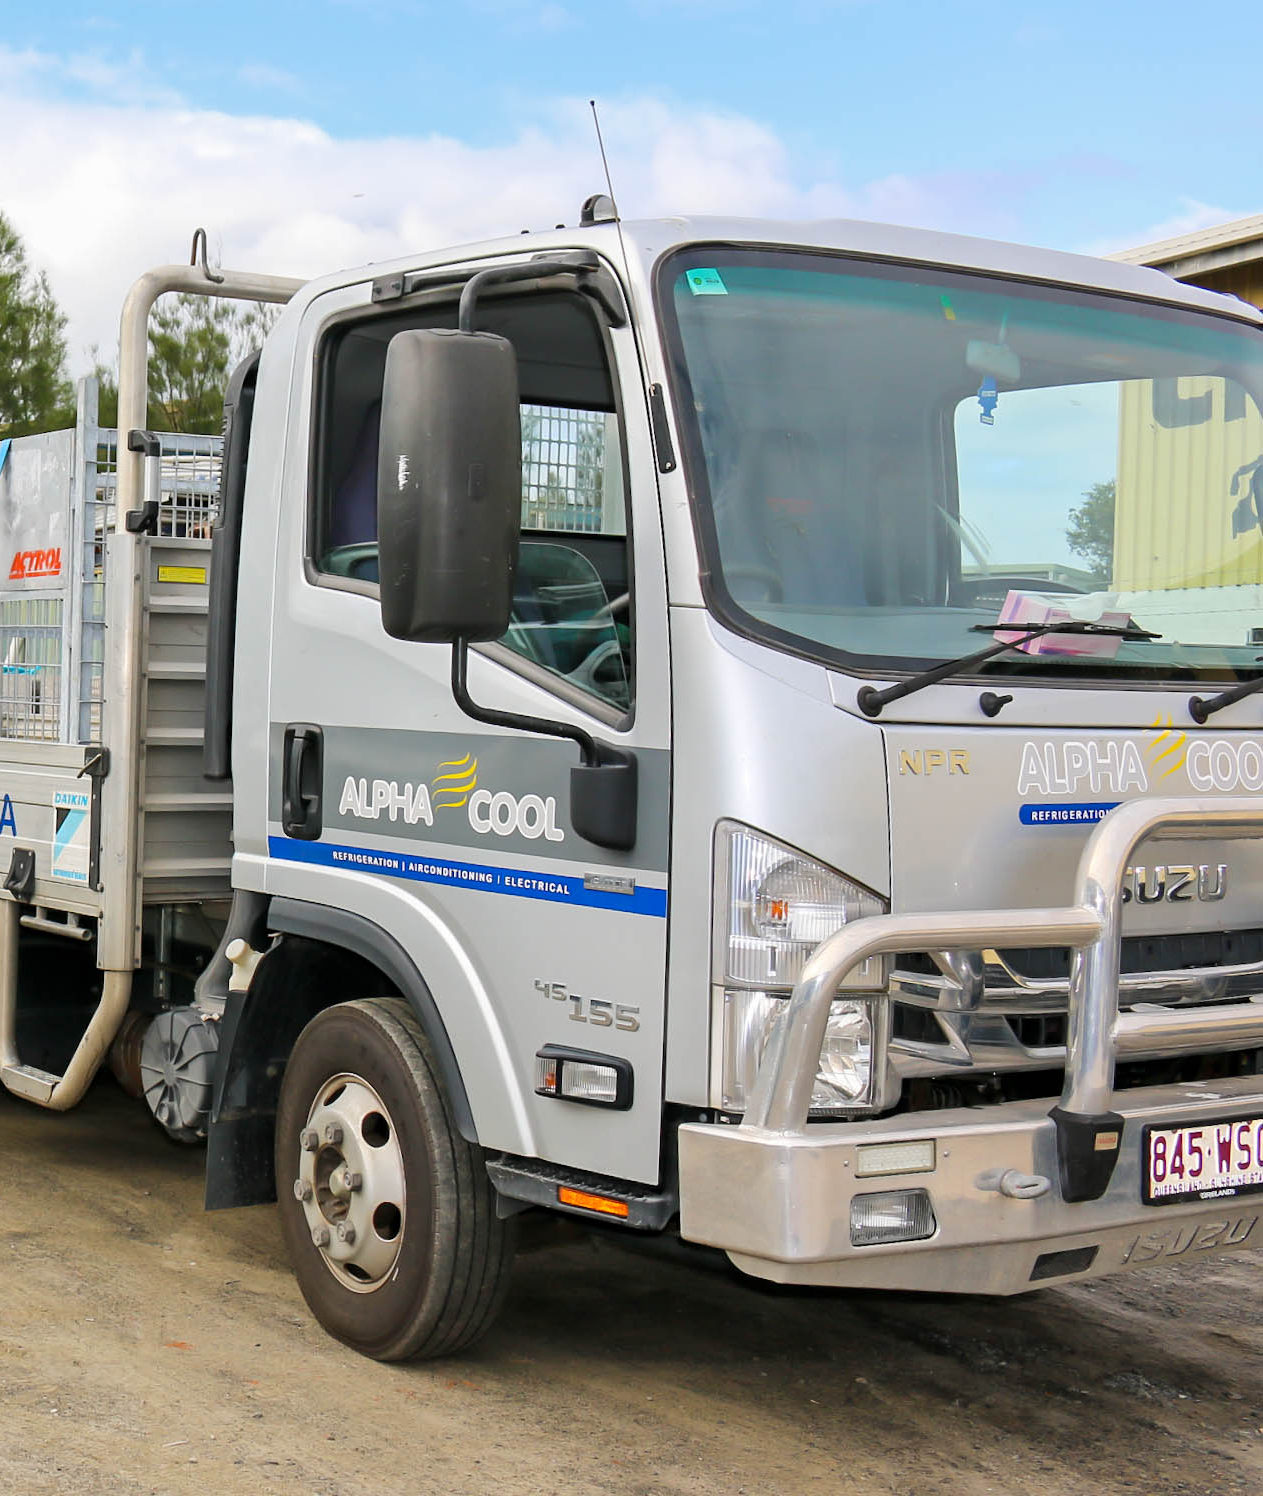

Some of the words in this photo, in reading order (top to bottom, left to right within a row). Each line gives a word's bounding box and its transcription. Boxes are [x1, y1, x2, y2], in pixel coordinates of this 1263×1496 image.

[9, 547, 62, 579] ACTROL
[899, 749, 970, 776] NPR
[1017, 741, 1148, 795] ALPHA
[55, 793, 88, 807] DAIKIN
[339, 776, 434, 827] ALPHA
[468, 789, 565, 841] COOL
[1031, 809, 1114, 821] REFRIGERATIO
[332, 851, 399, 869] REFRIGERATION
[408, 862, 493, 883] AIRCONDITIONING
[504, 876, 570, 895] ELECTRICAL
[534, 979, 567, 1002] 45
[568, 994, 641, 1032] 155
[1121, 1216, 1259, 1265] ISUZU
